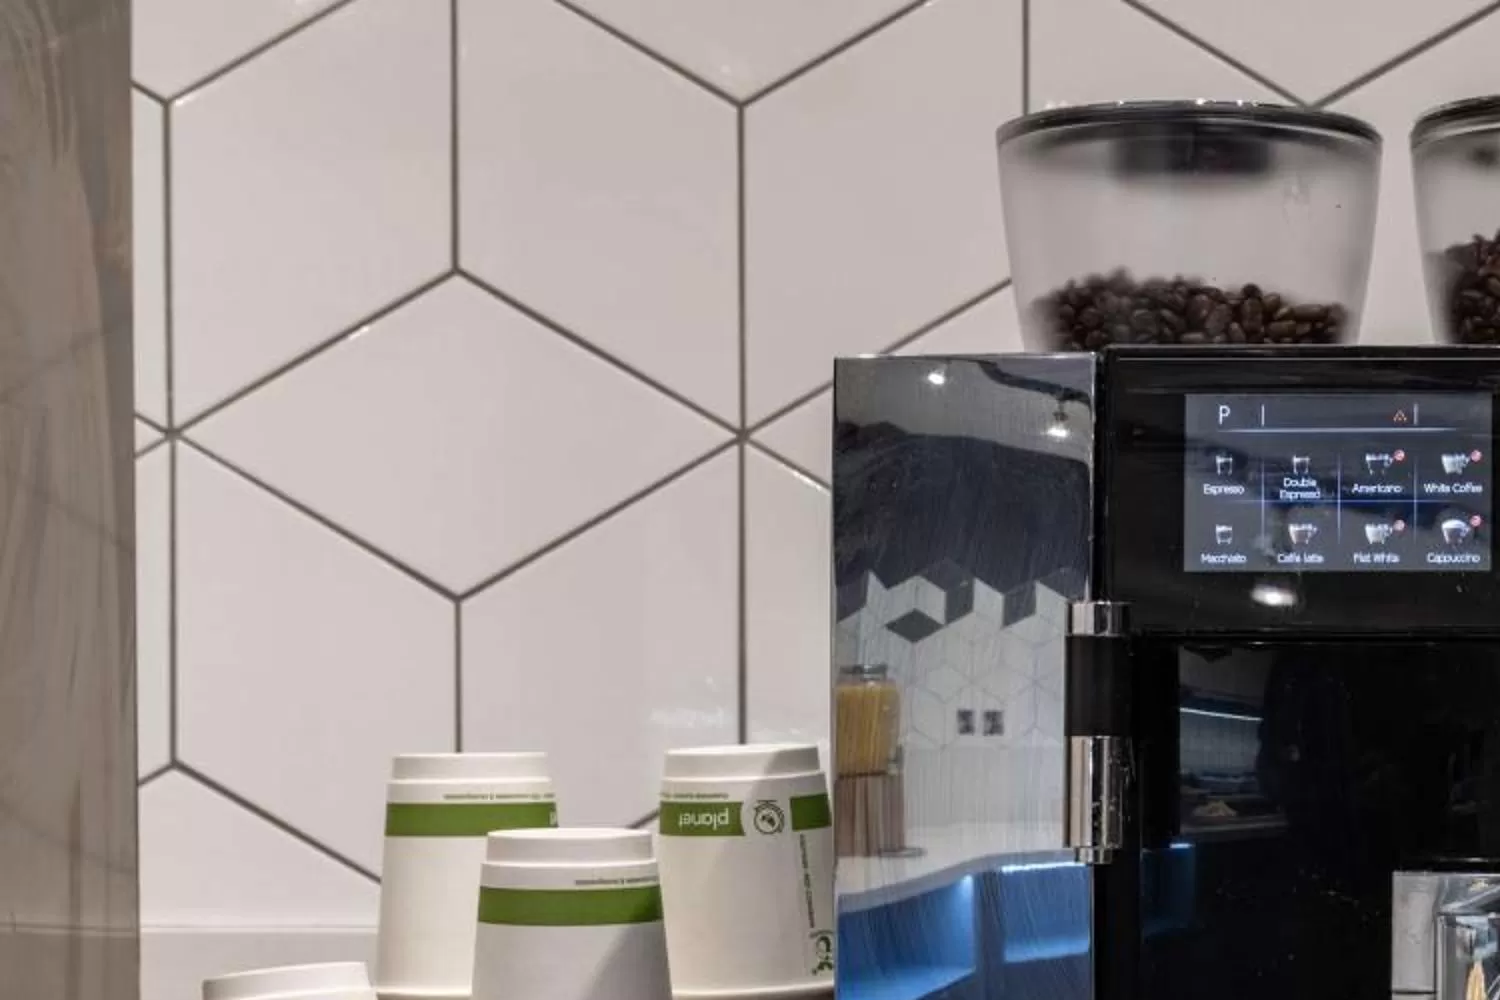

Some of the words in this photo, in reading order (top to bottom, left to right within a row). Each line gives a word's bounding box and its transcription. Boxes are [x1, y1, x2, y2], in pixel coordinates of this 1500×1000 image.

[1218, 404, 1231, 425] P
[1283, 478, 1317, 487] Double
[1352, 483, 1402, 493] Americano
[1424, 483, 1450, 493] White
[1452, 482, 1483, 493] Coffee
[1203, 483, 1245, 496] Espresso
[1279, 489, 1321, 500] Espresso
[1201, 553, 1247, 564] Macchiato
[1354, 552, 1371, 563] Flat
[1373, 552, 1400, 563] White
[1427, 552, 1481, 564] Cappuccino
[679, 808, 729, 830] planet
